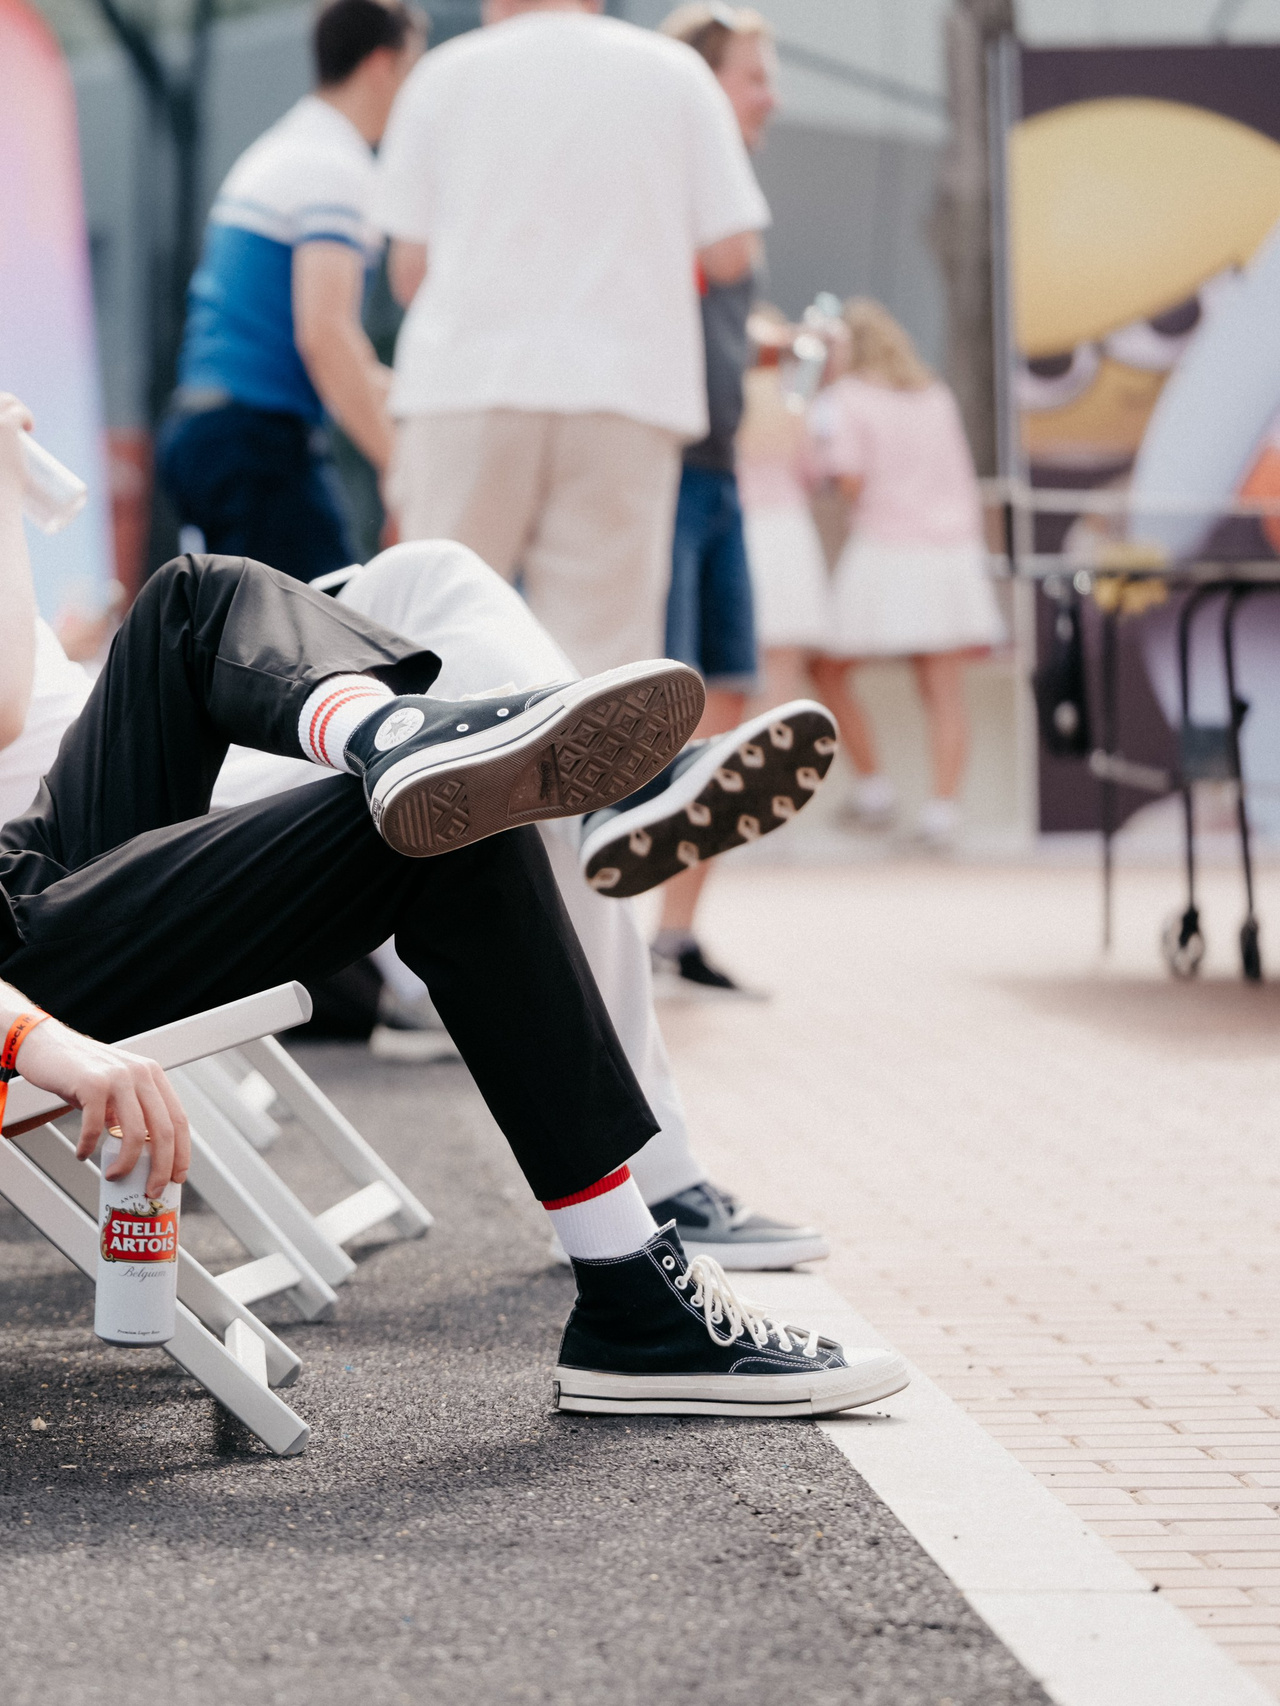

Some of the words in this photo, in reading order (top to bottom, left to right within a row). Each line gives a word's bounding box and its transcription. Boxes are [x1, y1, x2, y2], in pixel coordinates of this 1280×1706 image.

[8, 1024, 26, 1052] rock
[120, 1193, 139, 1204] ANNO
[111, 1219, 175, 1236] STELLA
[109, 1236, 175, 1253] ARTOIS
[119, 1265, 167, 1283] Belgium
